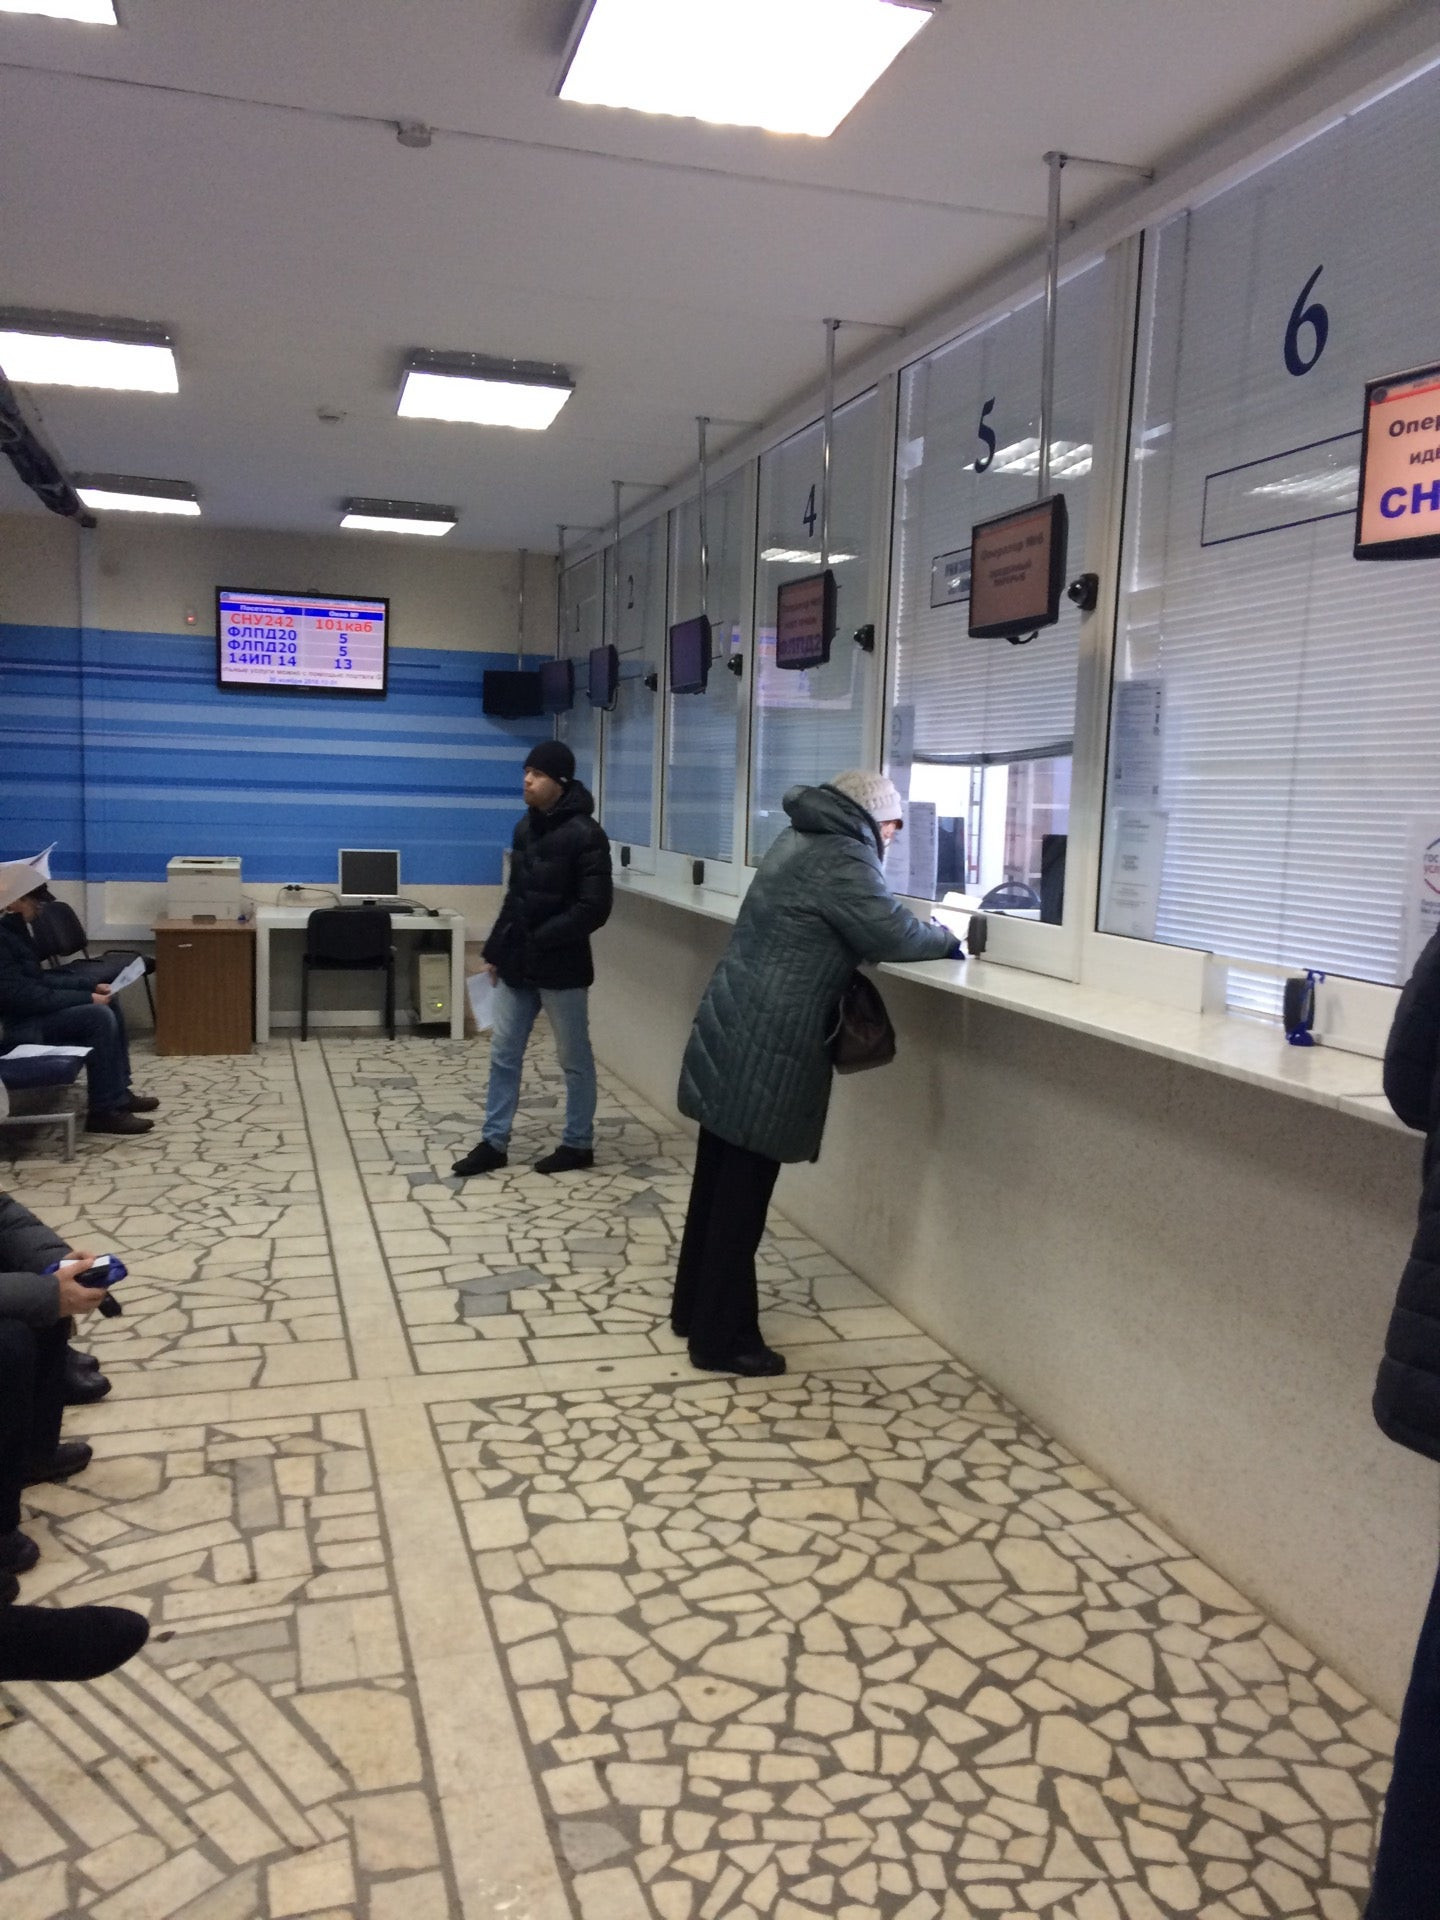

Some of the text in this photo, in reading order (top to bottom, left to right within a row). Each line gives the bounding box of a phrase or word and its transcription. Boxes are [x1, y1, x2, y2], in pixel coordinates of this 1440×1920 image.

[1284, 264, 1329, 377] 6
[974, 396, 996, 474] 5
[1380, 479, 1440, 519] СН
[802, 483, 817, 538] 4
[230, 613, 294, 628] СНУ242
[315, 618, 373, 633] 101каб
[227, 626, 297, 641] ФЛПД20
[339, 633, 348, 644] 5
[227, 639, 297, 654] ФЛПД20
[339, 646, 348, 657] 5
[229, 653, 297, 667] 14ИП 14
[334, 658, 352, 670] 13
